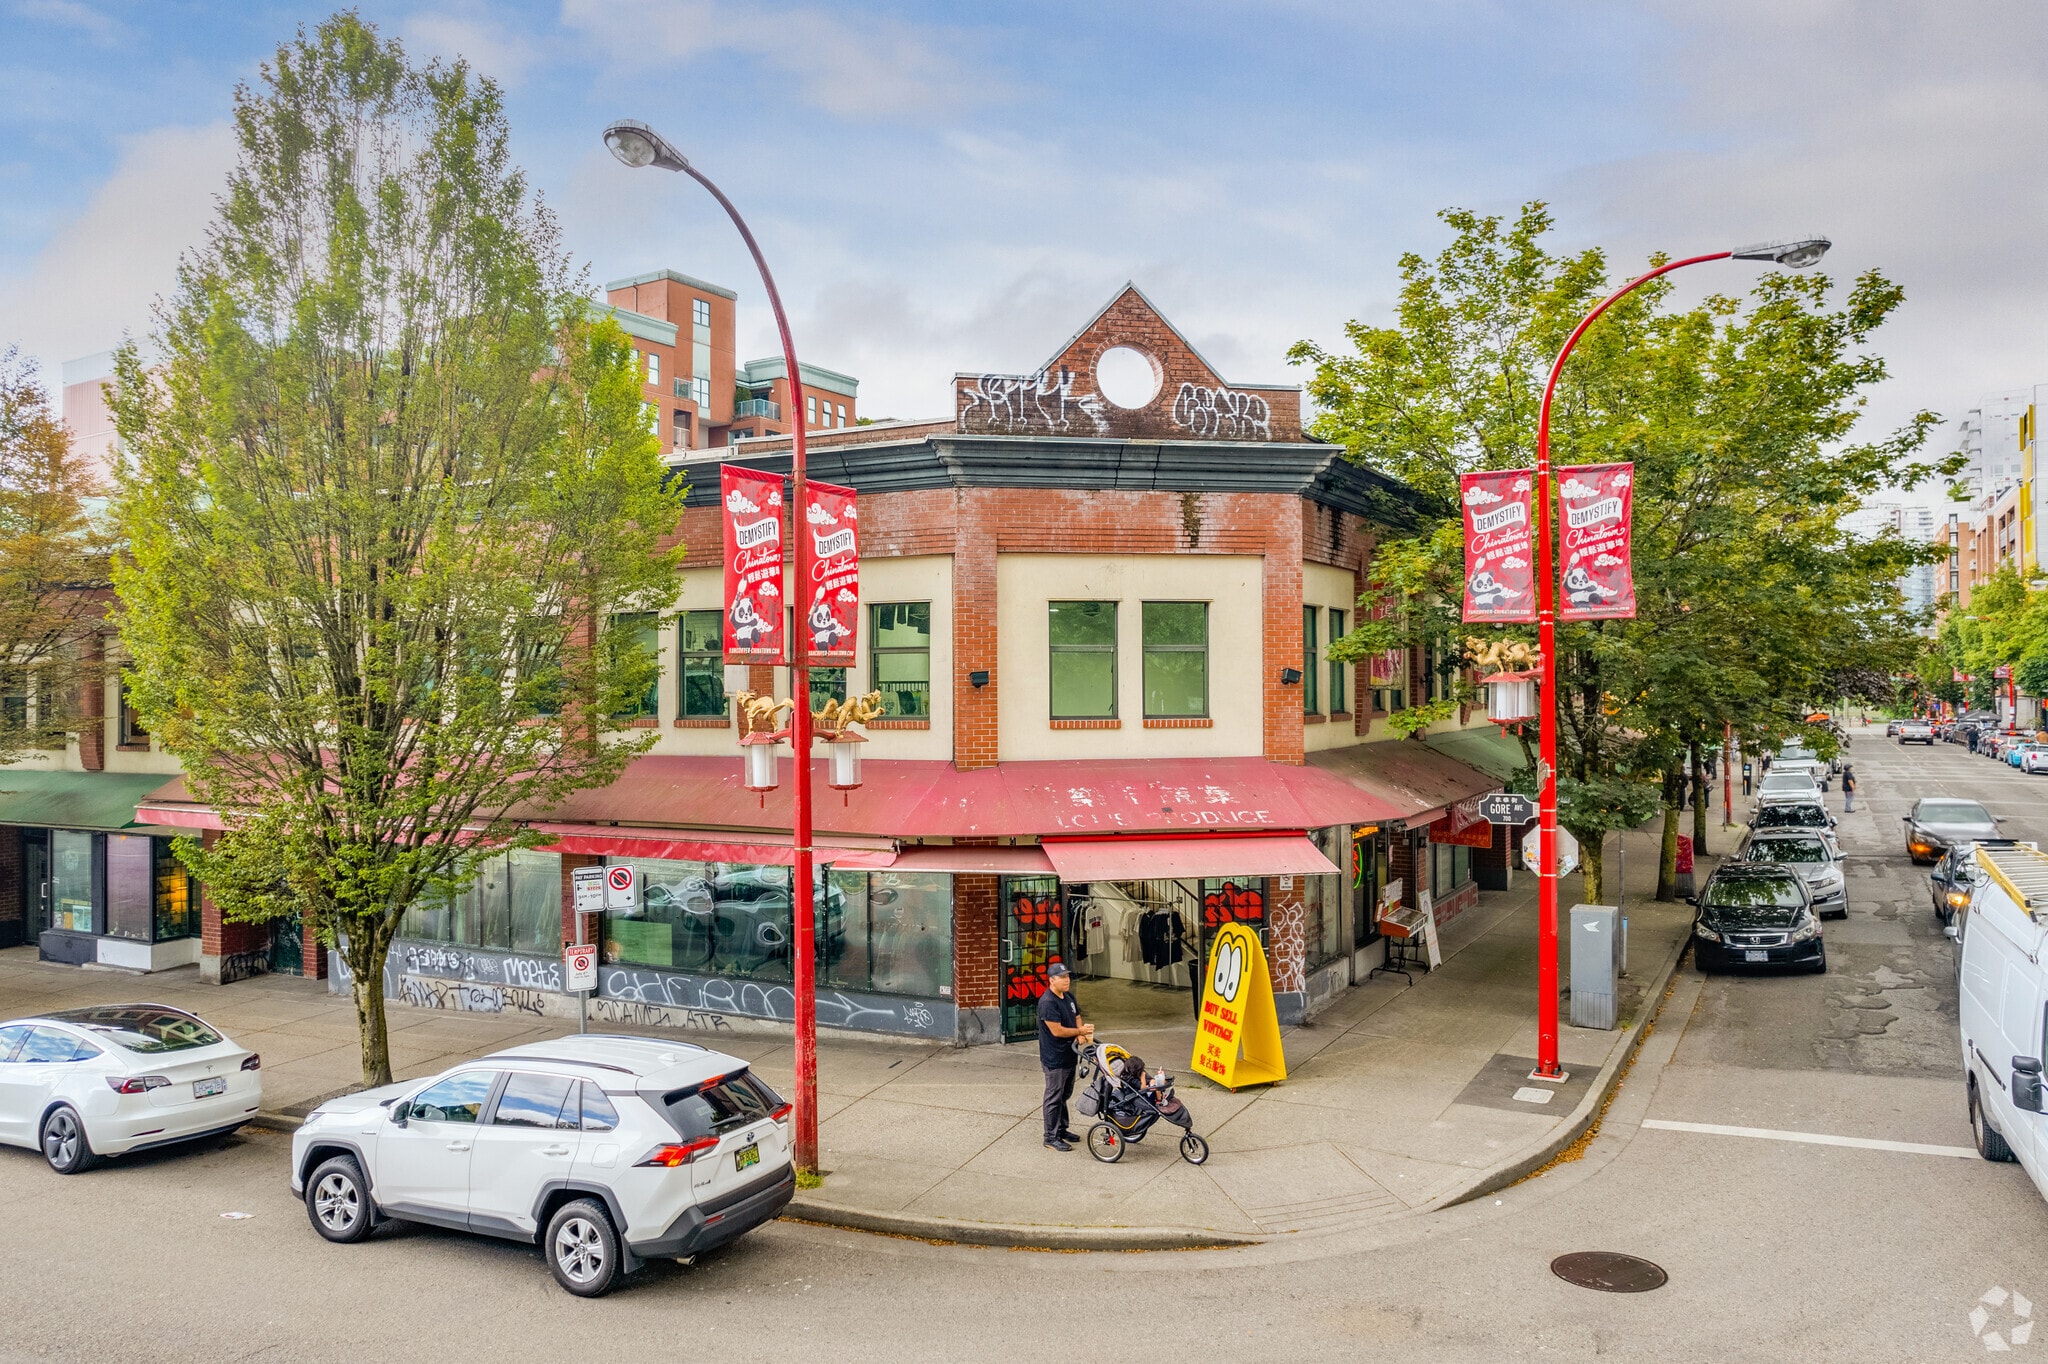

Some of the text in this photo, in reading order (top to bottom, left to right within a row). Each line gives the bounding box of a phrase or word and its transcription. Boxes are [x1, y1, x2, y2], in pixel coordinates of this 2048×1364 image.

[1477, 505, 1522, 531] DEMYSTIFY
[1571, 501, 1618, 525] DEMYSTIFY
[739, 521, 776, 545] DEMYSTIFY
[819, 533, 851, 554] DEMYSTIFY
[1471, 528, 1529, 554] Chinatown
[1566, 524, 1626, 549] Chinatown
[1490, 804, 1524, 815] GORE AVE
[569, 947, 594, 955] TEMPORARY
[1204, 1000, 1238, 1025] BUY SELL
[1203, 1019, 1233, 1043] VINTAGE
[1207, 1043, 1221, 1059] 买卖
